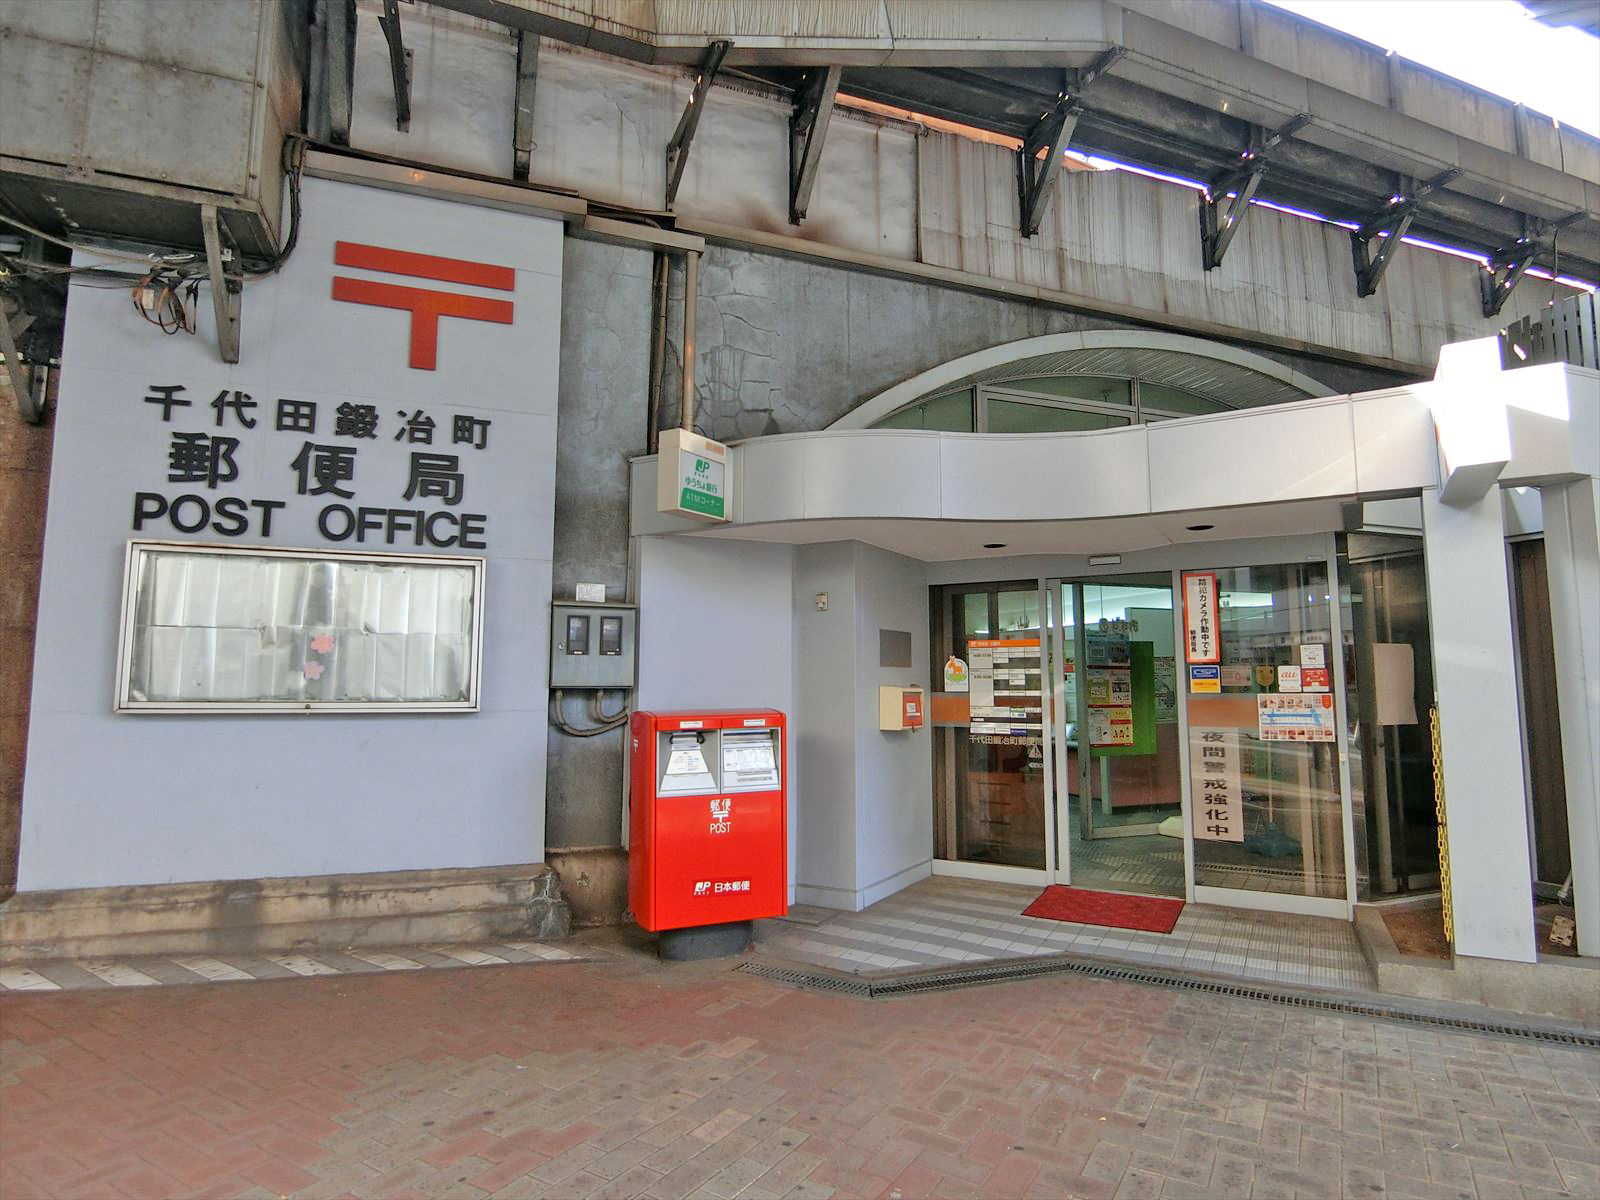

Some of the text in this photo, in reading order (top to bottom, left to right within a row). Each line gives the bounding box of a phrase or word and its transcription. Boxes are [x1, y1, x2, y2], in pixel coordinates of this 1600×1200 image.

[168, 431, 465, 506] 郵便局
[685, 477, 717, 494] ゆうちょ銀行
[133, 492, 487, 549] POST OFFICE
[1198, 578, 1211, 657] 防犯カメラ作動中です
[1281, 671, 1298, 679] au
[1201, 731, 1229, 836] 夜間警戒強化中
[710, 798, 732, 812] 郵便
[710, 822, 732, 834] POST
[714, 880, 750, 893] 日本郵便
